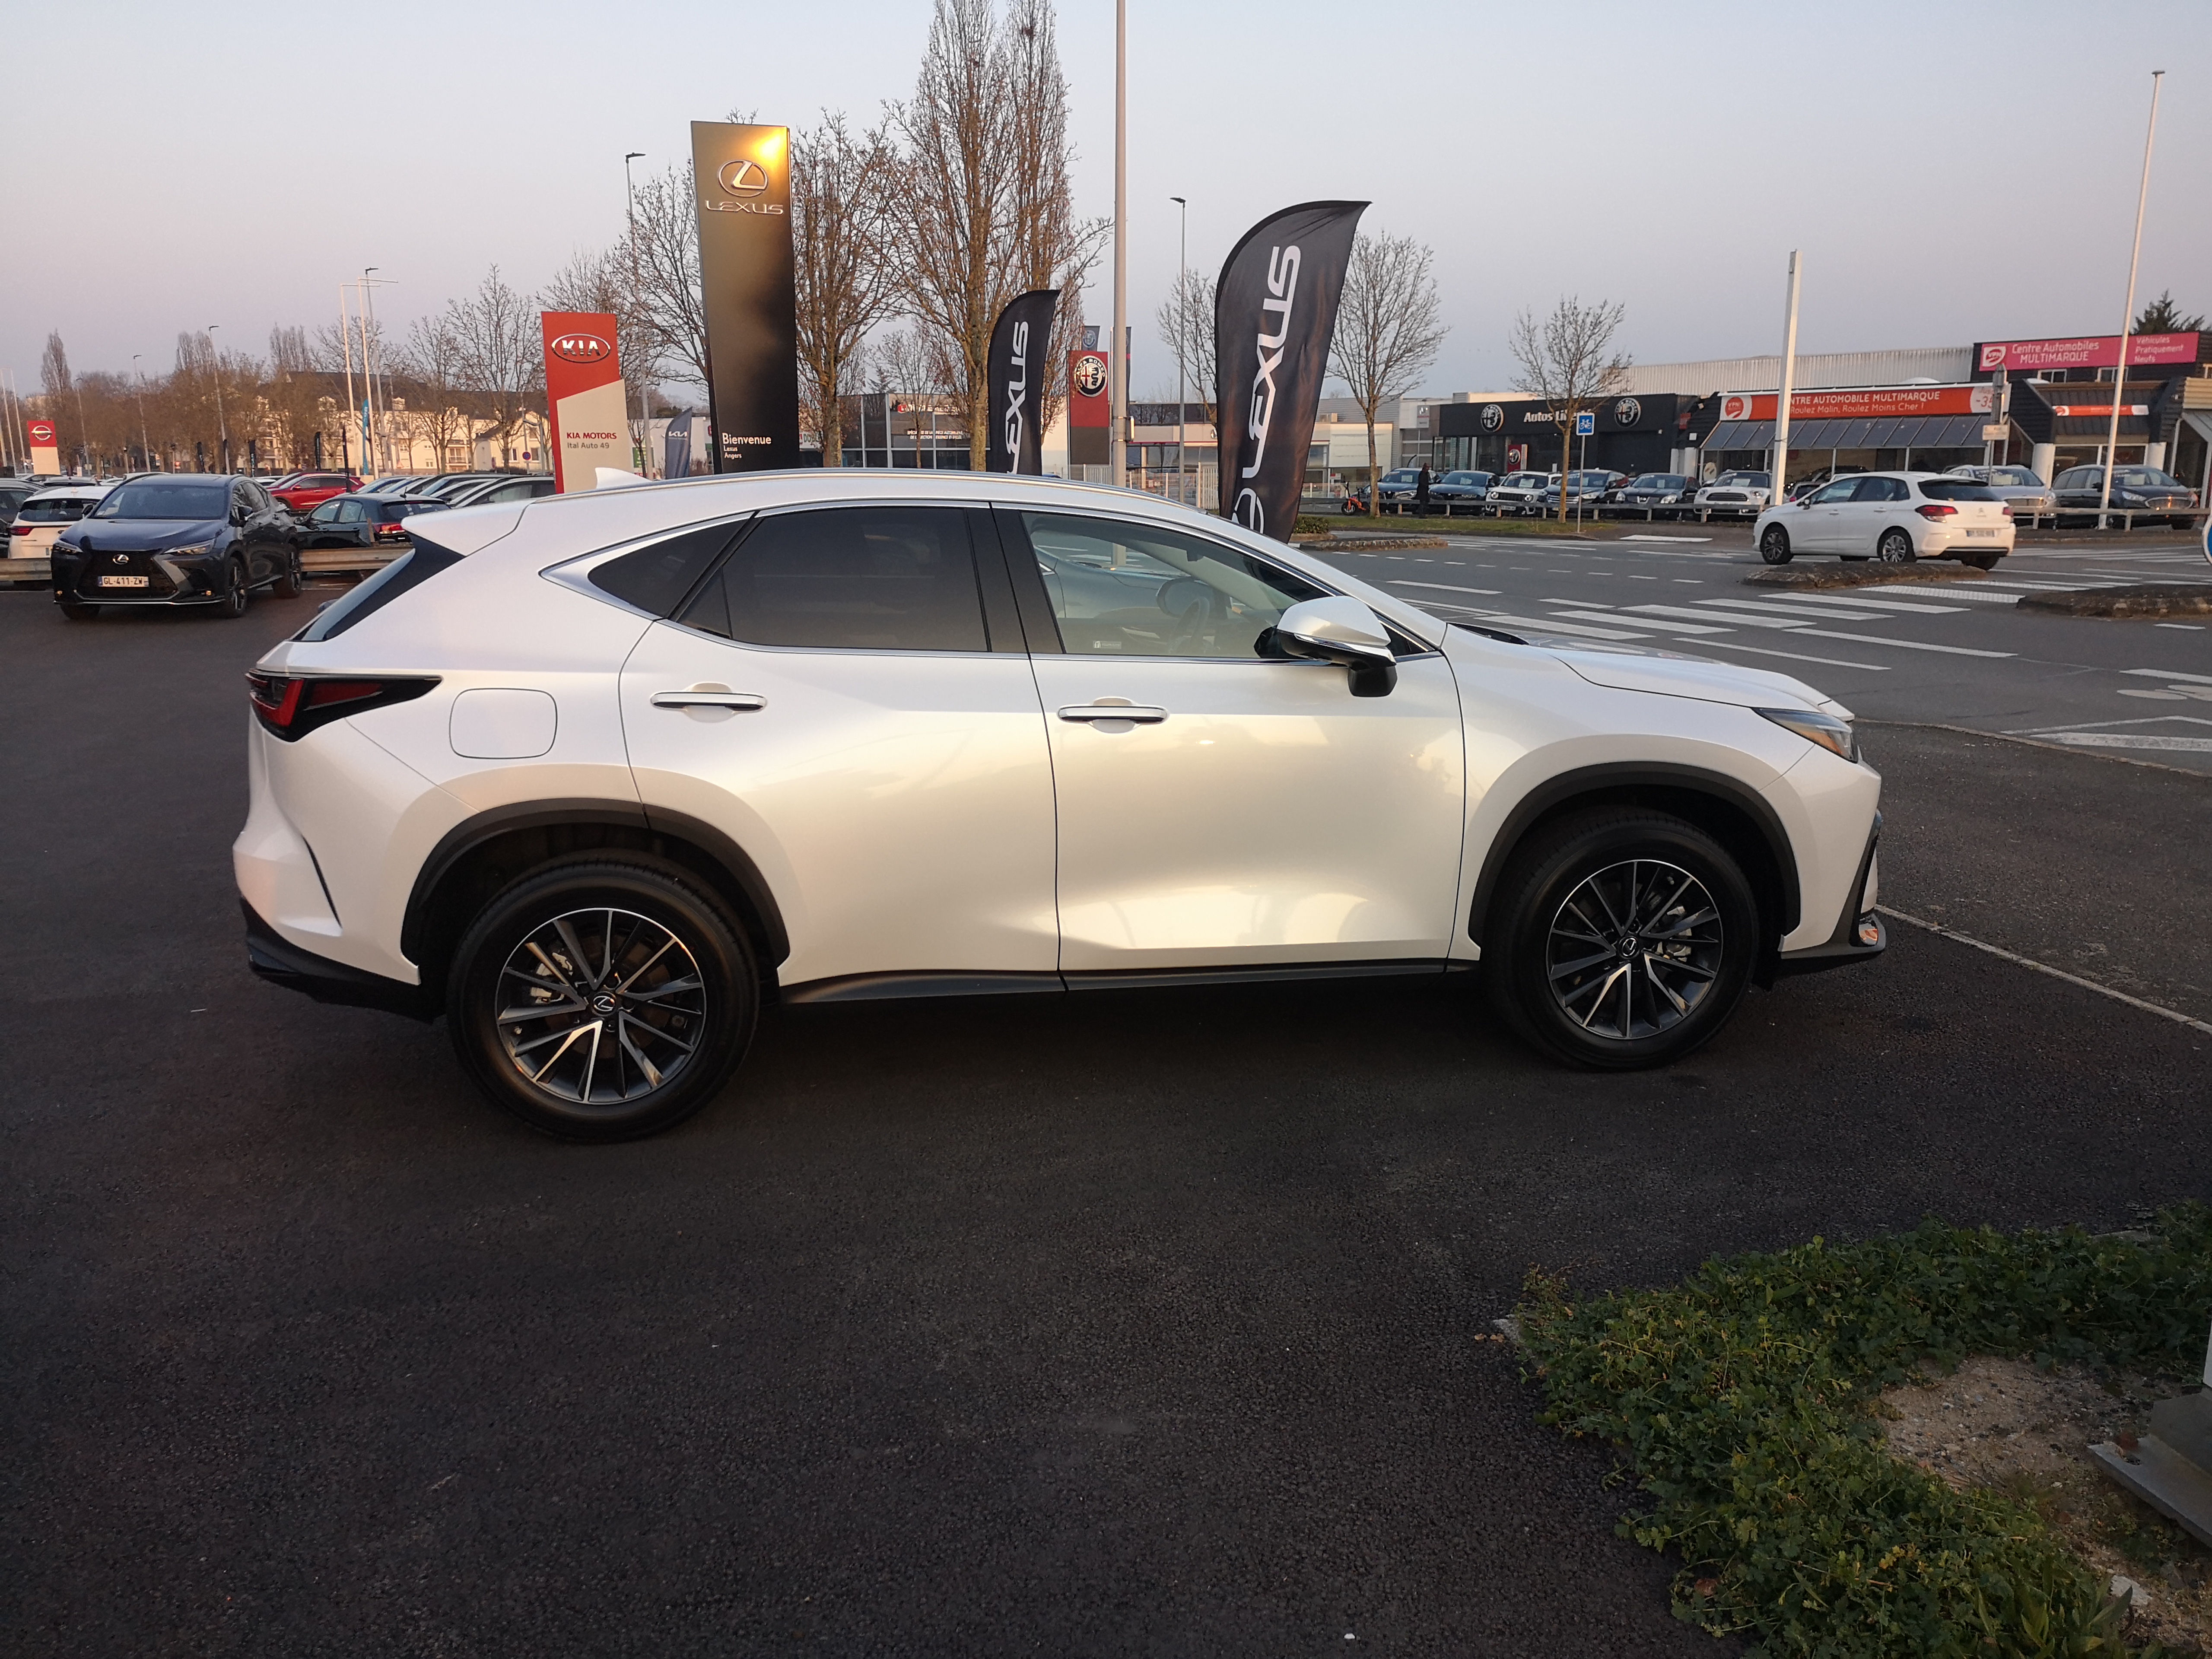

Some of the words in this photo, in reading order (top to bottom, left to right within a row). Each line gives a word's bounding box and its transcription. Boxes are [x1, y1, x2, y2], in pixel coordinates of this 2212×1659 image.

[705, 200, 784, 215] LEXUS
[562, 340, 601, 356] KIA
[2012, 343, 2040, 354] Centre
[2043, 340, 2100, 352] Automobiles
[1243, 245, 1301, 478] LEXUS
[2020, 351, 2089, 364] MULTIMARQUE
[1790, 396, 1811, 405] NTRE
[1813, 394, 1870, 404] AUTOMOBILE
[1872, 391, 1941, 402] MULTIMARQUE
[1842, 404, 1869, 413] Roulez
[1898, 402, 1918, 410] Cher
[1523, 411, 1553, 423] Autos
[722, 432, 772, 445] Bienvenue
